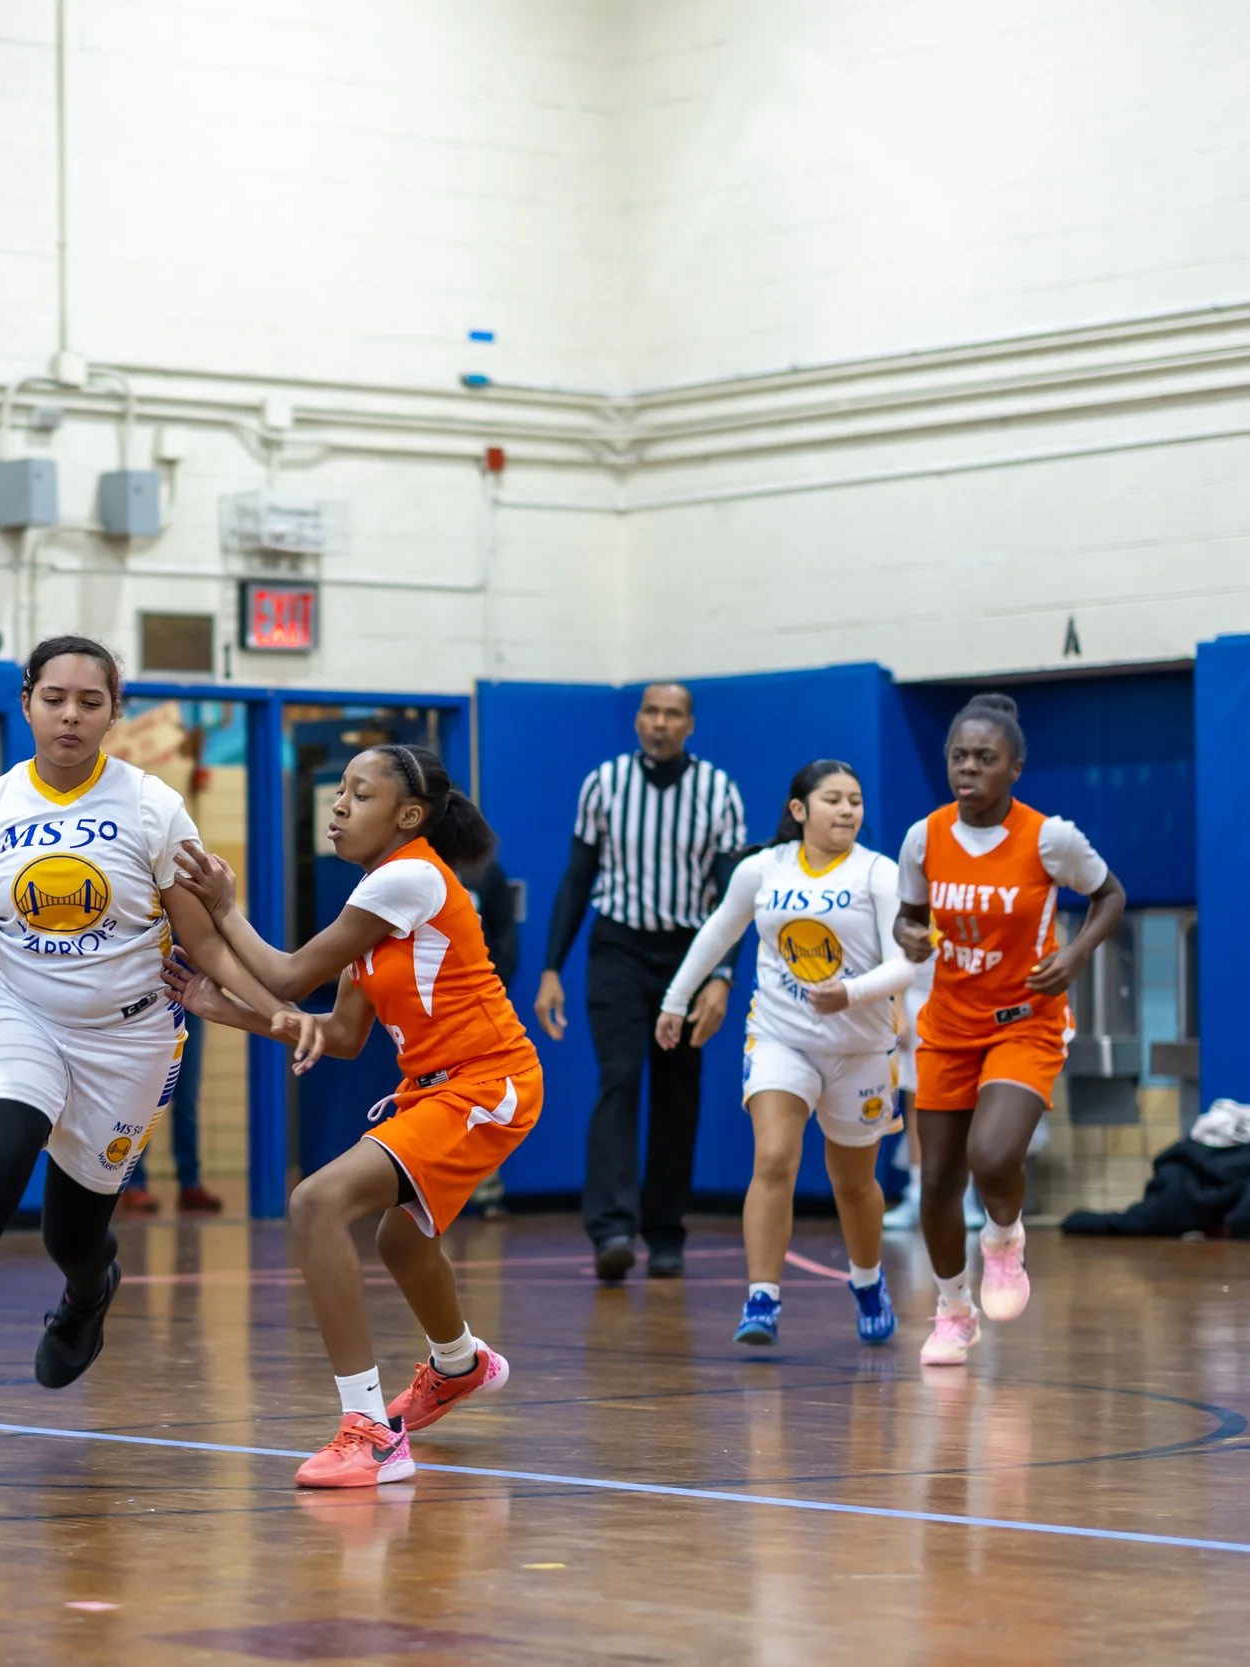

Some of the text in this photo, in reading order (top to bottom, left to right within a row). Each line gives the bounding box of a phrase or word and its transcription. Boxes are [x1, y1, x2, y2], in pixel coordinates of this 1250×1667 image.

[254, 587, 316, 648] EXIT
[1062, 614, 1081, 658] A
[0, 818, 118, 854] MS 50
[766, 888, 851, 915] MS 50
[931, 878, 1020, 915] UNITY
[955, 914, 982, 943] 11
[942, 938, 1004, 975] PREP
[112, 1121, 132, 1135] MS
